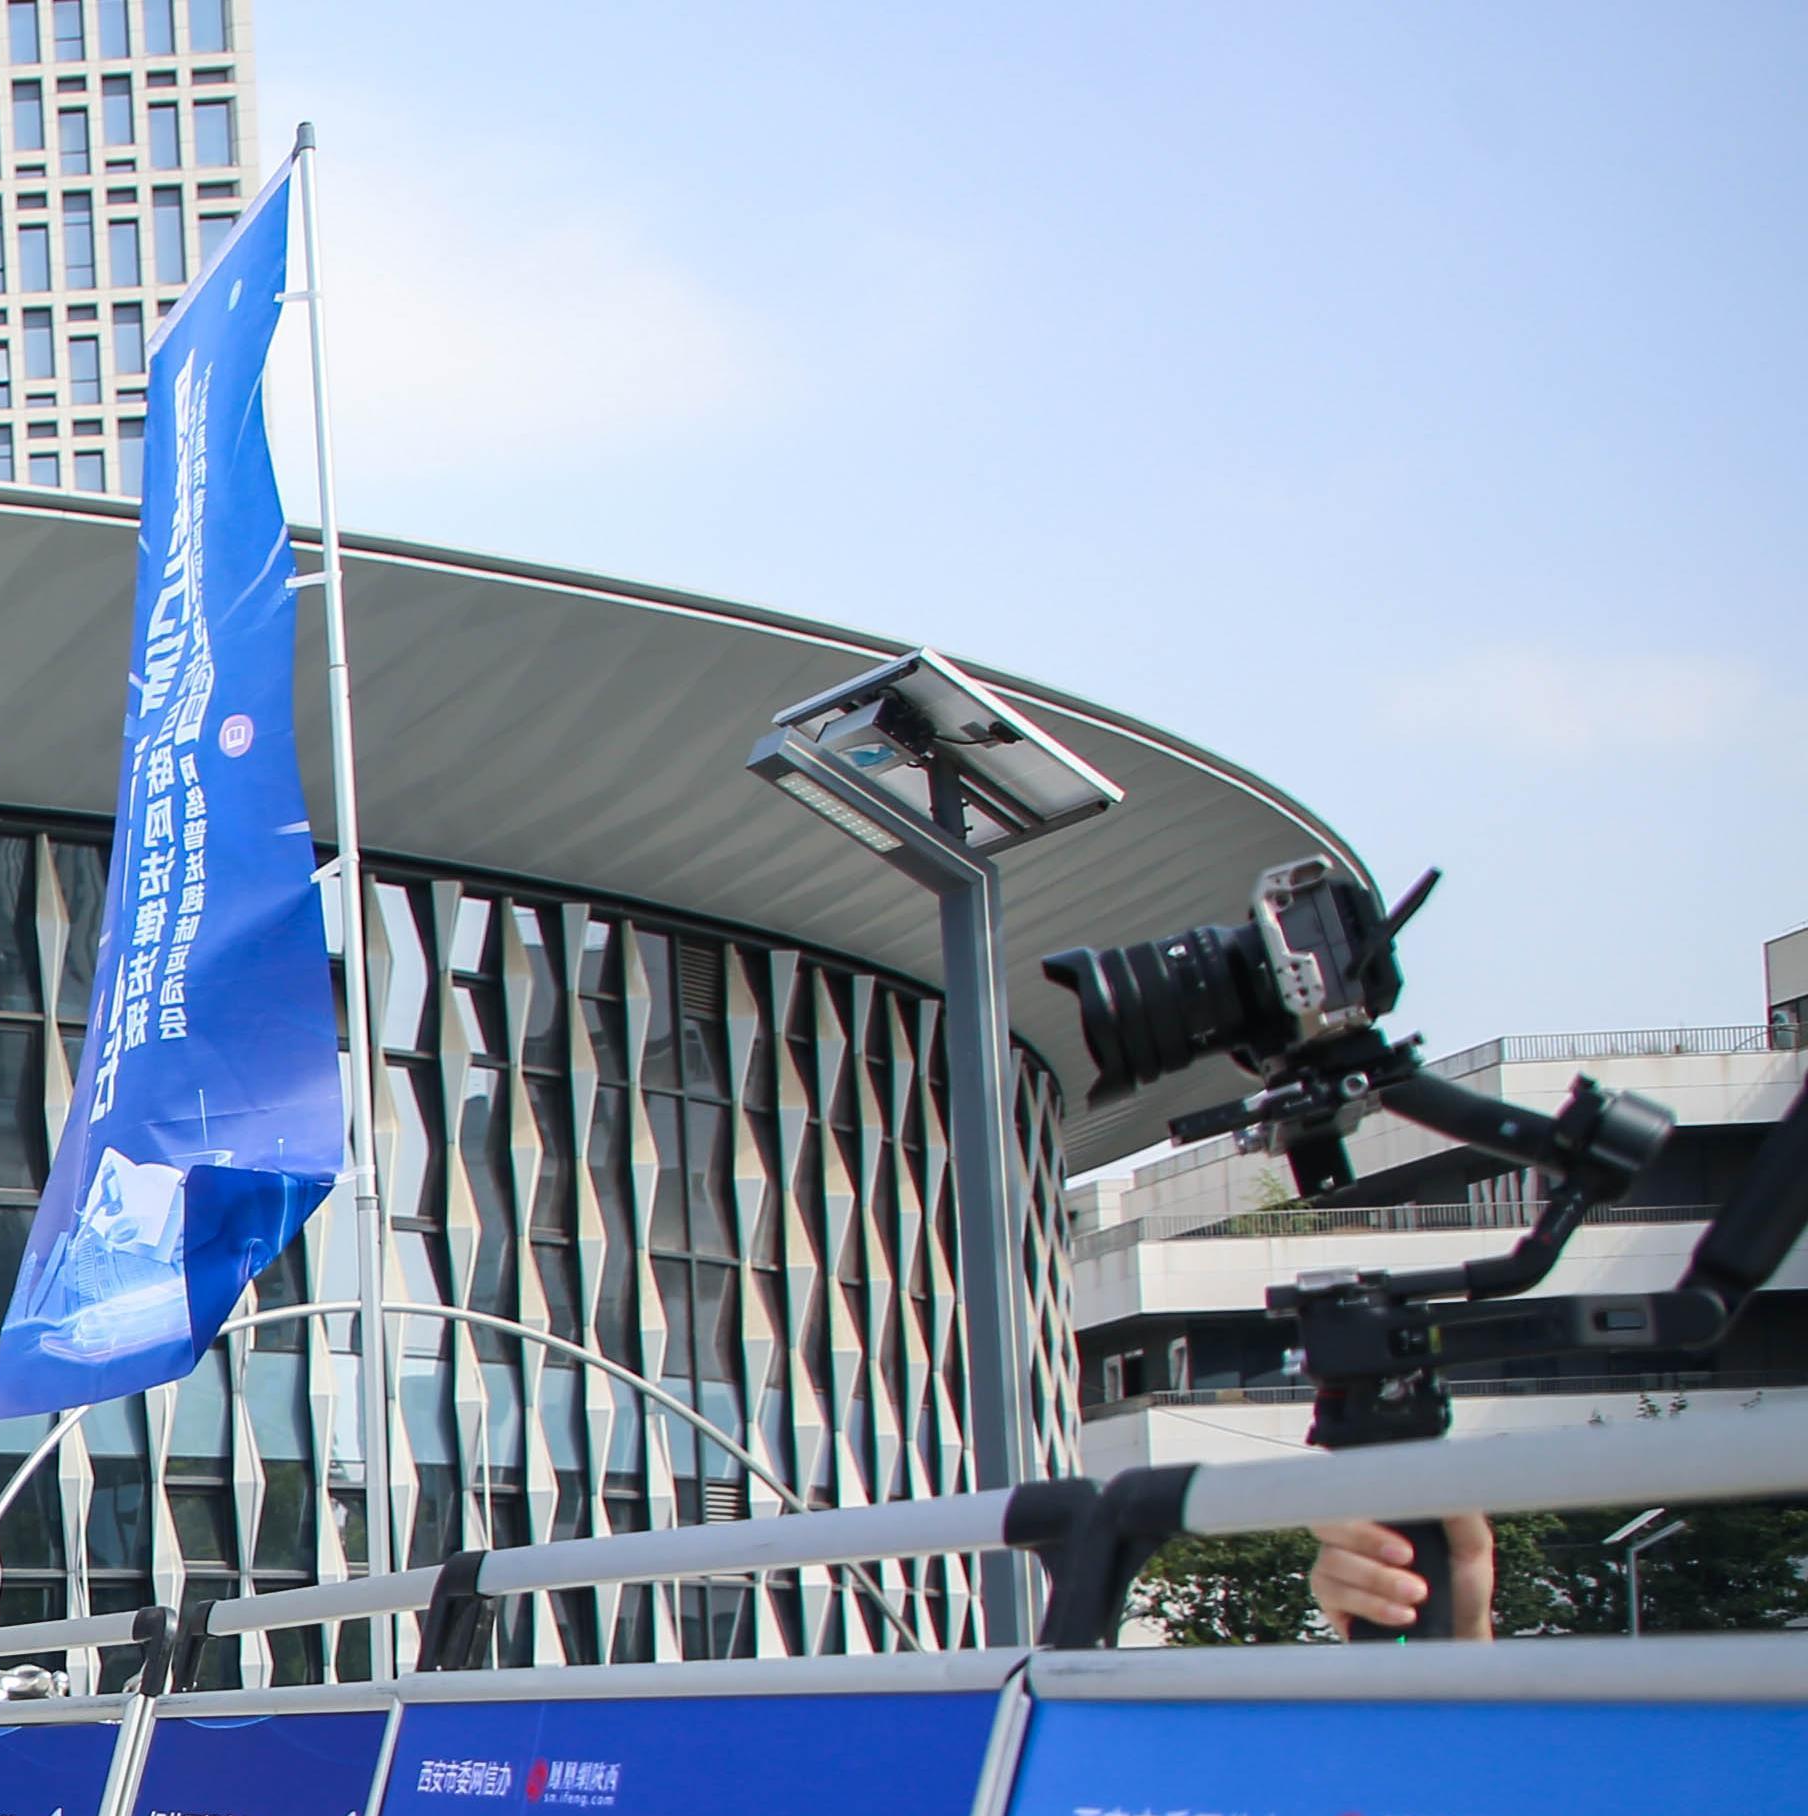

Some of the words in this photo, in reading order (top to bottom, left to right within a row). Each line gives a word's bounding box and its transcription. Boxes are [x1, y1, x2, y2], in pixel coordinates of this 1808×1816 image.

[416, 1759, 513, 1797] 西安市委网信办
